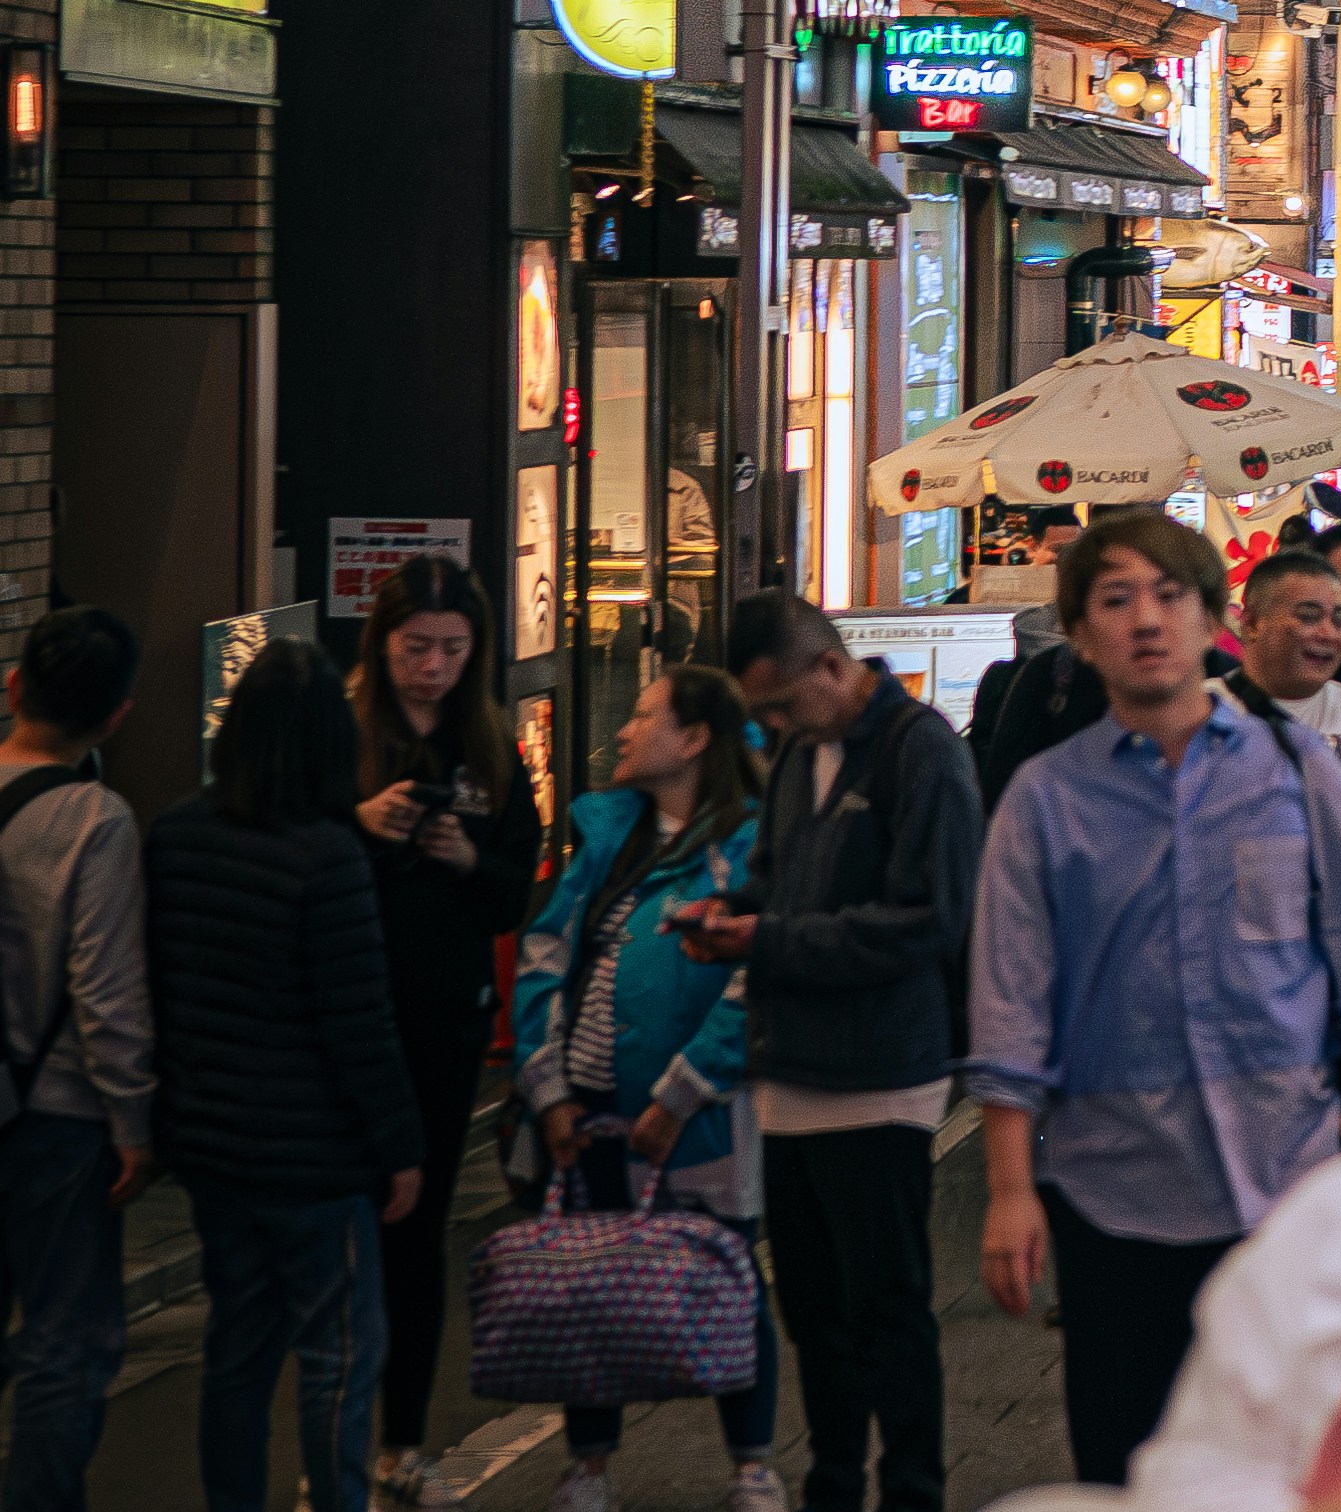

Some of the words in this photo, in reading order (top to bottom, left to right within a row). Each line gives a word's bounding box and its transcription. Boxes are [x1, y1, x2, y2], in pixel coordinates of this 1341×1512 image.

[886, 20, 1025, 58] Trattoria
[887, 60, 1017, 95] Pizzeria
[918, 95, 981, 128] Bar
[1270, 440, 1335, 466] BACARDI
[1076, 469, 1150, 485] BACARDI
